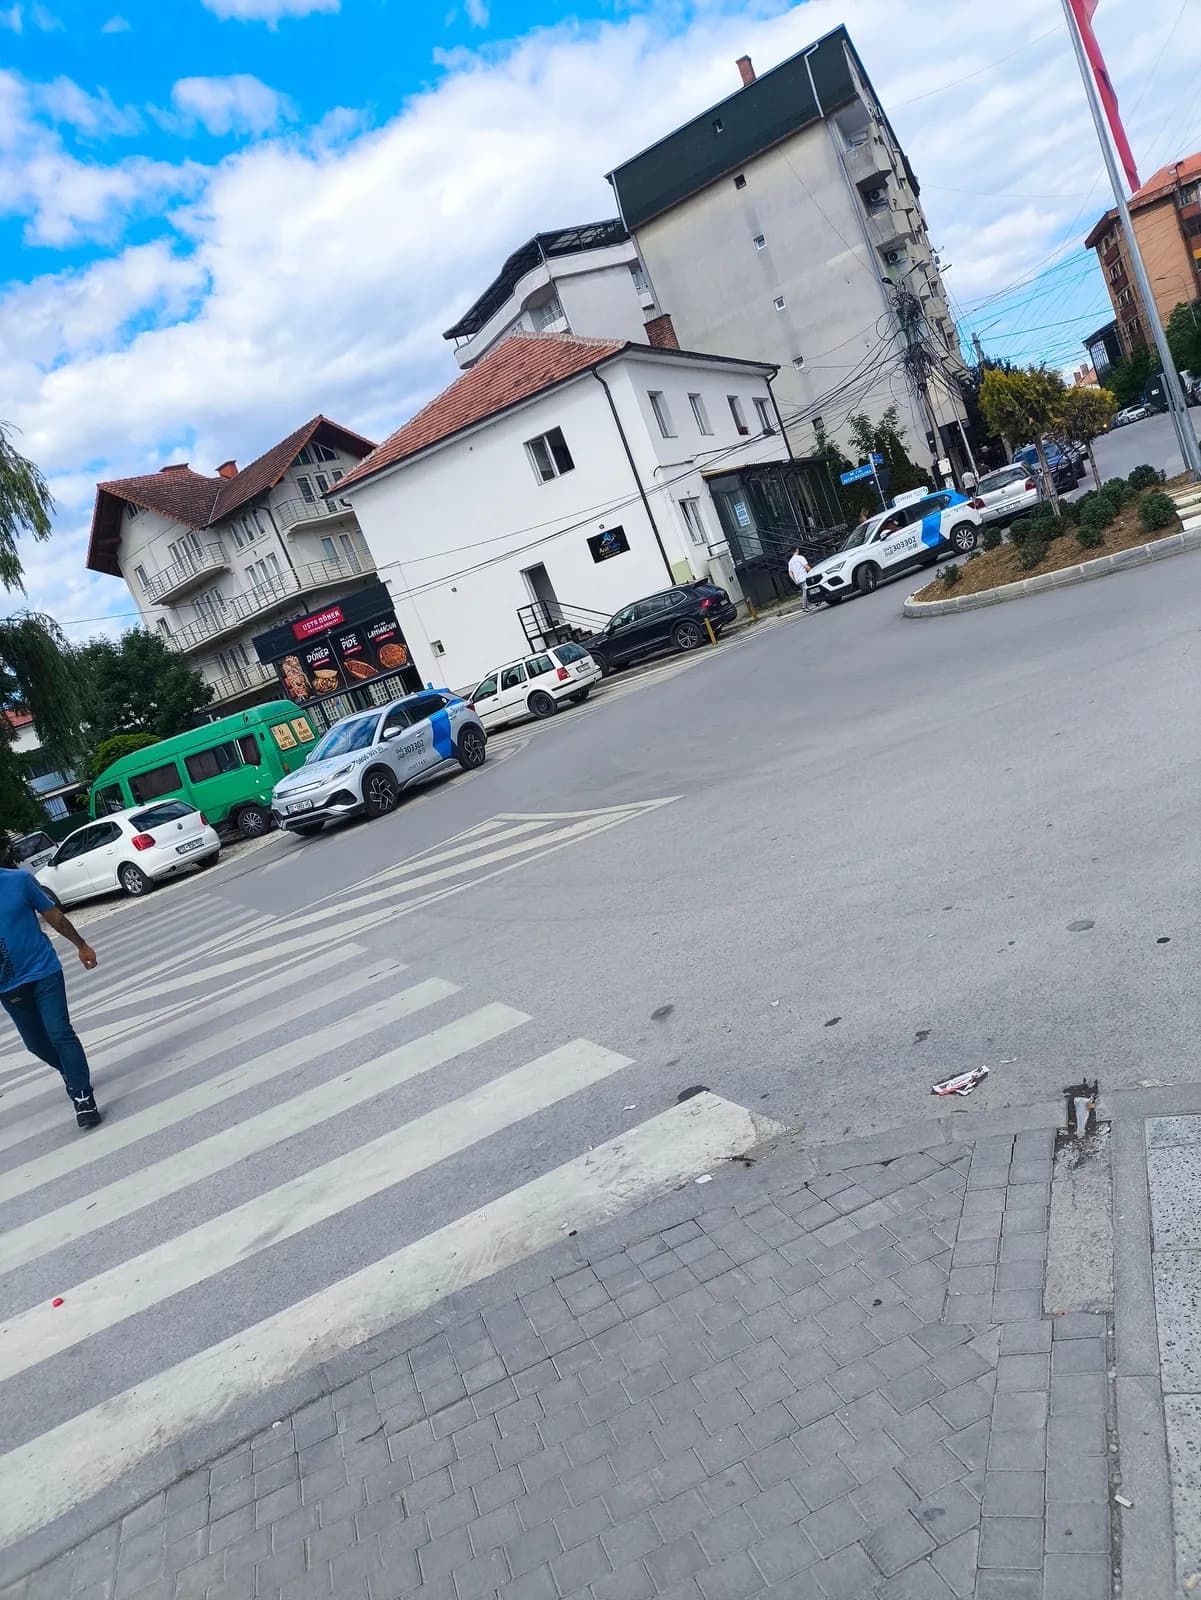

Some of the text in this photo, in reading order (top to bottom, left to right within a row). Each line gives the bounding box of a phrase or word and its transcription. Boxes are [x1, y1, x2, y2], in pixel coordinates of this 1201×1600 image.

[892, 536, 916, 551] 303302
[302, 619, 319, 630] USTA
[341, 637, 358, 650] PIDE
[403, 740, 425, 755] 303302
